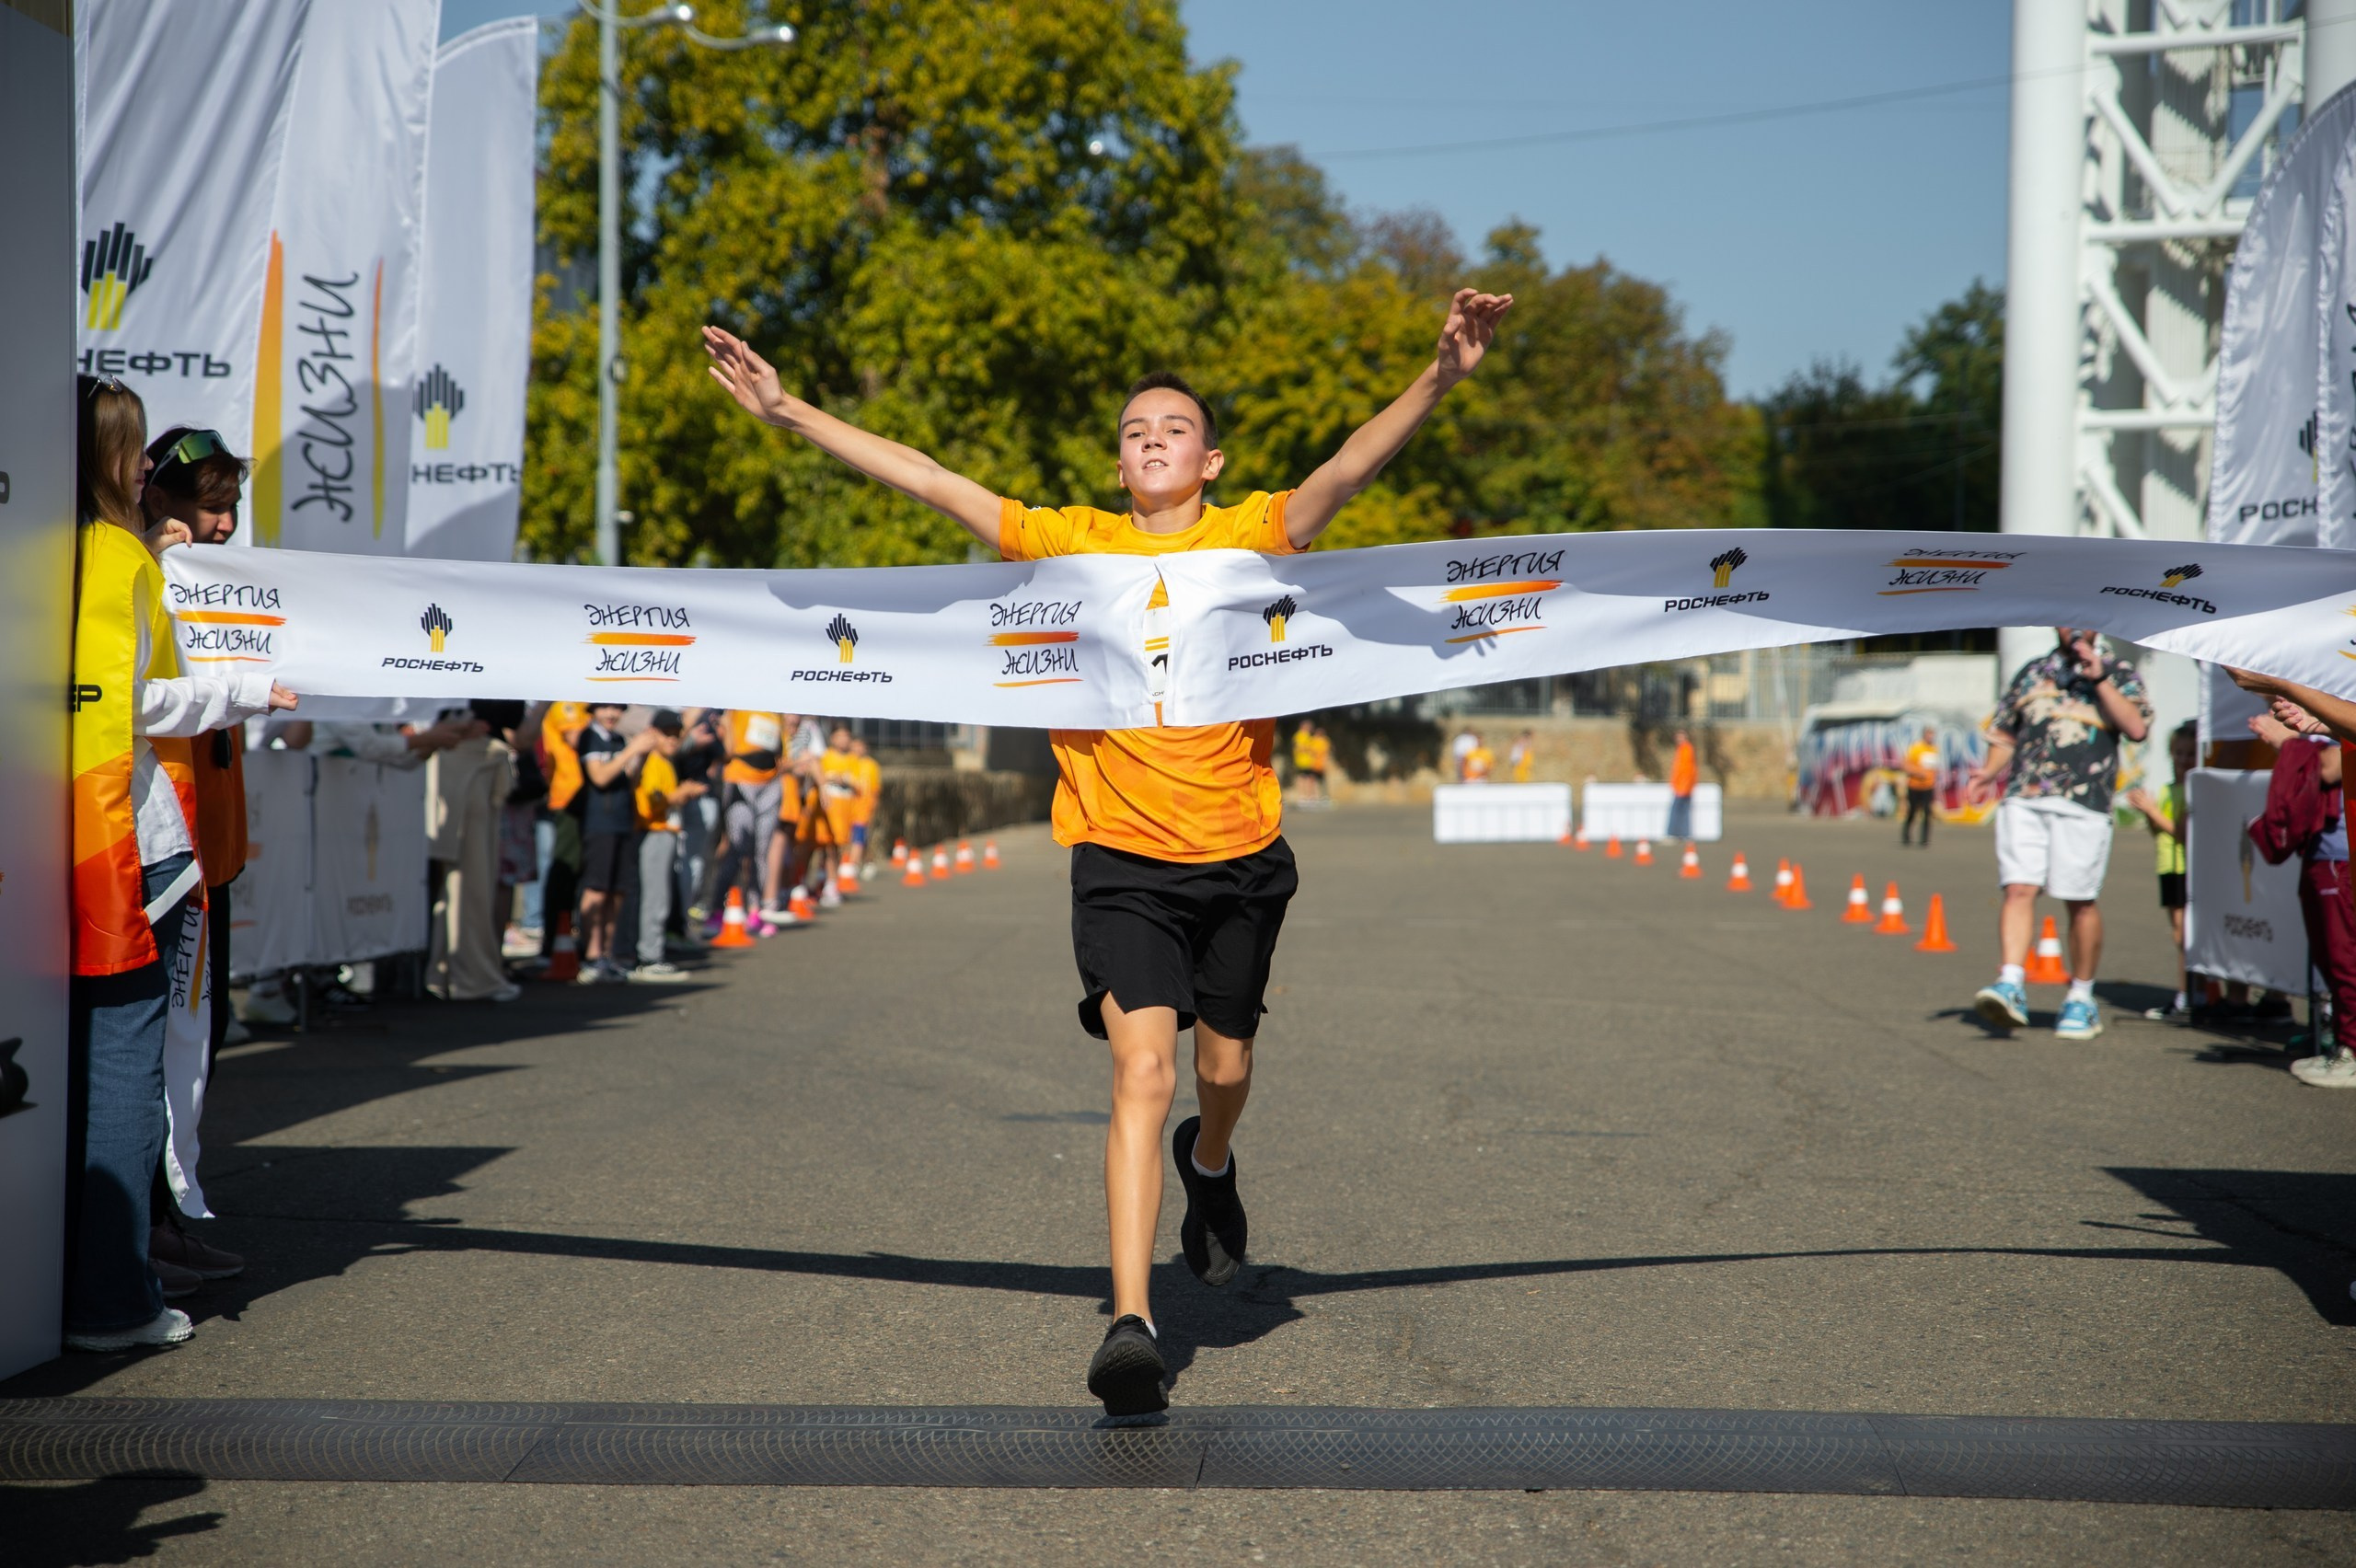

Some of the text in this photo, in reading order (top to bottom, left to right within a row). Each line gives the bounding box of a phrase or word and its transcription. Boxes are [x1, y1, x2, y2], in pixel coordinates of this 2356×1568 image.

[290, 271, 360, 523] ЖИЗНИ
[1447, 549, 1565, 582] ЭНЕРГИЯ
[1888, 569, 1987, 585] ЖИЗНИ
[169, 583, 281, 609] ЭНЕРГИЯ
[1664, 591, 1770, 613] РОСНЕФТЬ
[2100, 586, 2217, 615] РОСНЕФТЬ
[583, 604, 690, 628] ЭНЕРГИЯ
[990, 601, 1082, 627] ЭНЕРГИЯ
[1450, 596, 1542, 629] ЖИЗНИ
[186, 626, 271, 654] ЖИЗНИ
[382, 658, 484, 673] РОСНЕФТЬ
[595, 648, 681, 674] ЖИЗНИ
[1001, 648, 1079, 674] ЖИЗНИ
[1229, 644, 1333, 671] РОСНЕФТЬ
[791, 670, 893, 683] РОСНЕФТЬ
